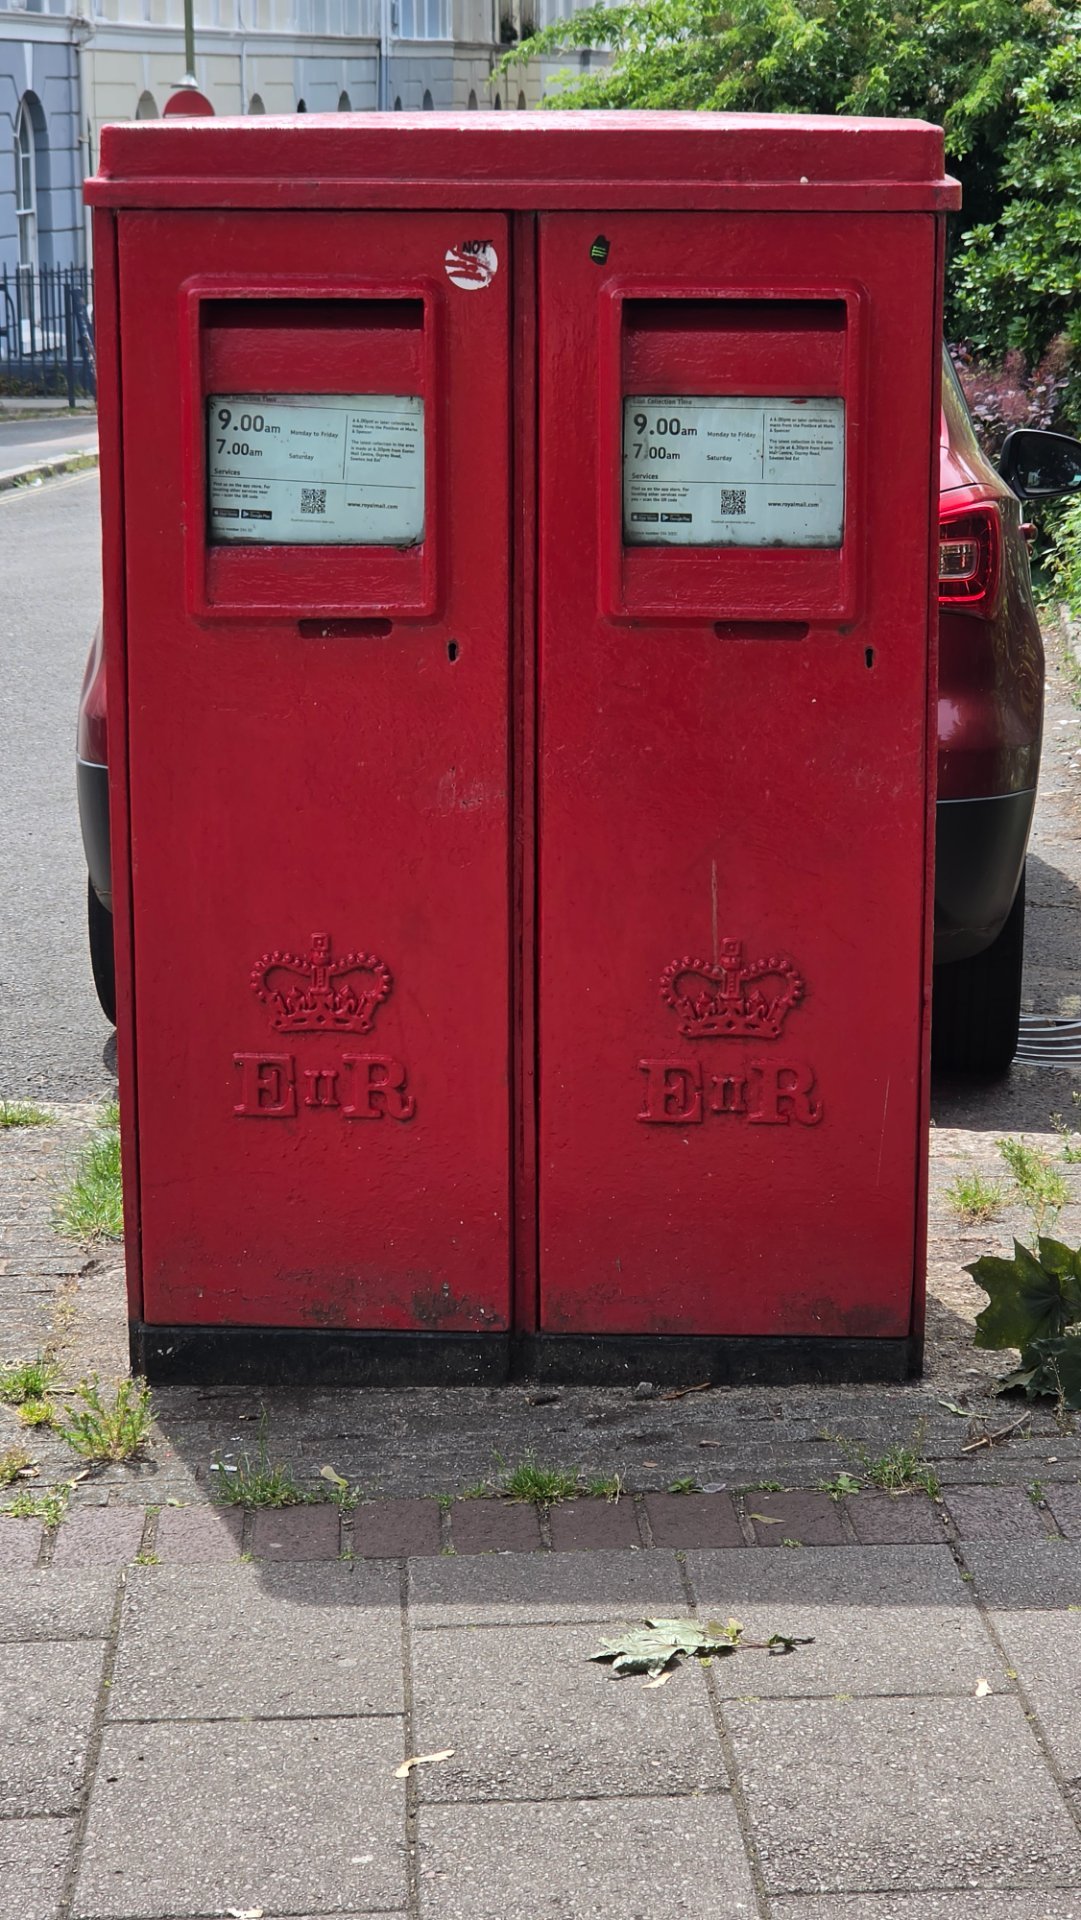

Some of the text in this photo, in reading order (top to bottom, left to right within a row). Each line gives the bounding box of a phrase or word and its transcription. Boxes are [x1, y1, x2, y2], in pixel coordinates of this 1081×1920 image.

[462, 240, 493, 254] NOT
[218, 409, 281, 433] 9.00am
[634, 413, 697, 436] 9.00am
[216, 439, 263, 456] 7.00am
[289, 453, 314, 461] Saturday
[706, 454, 732, 462] Saturday
[214, 468, 240, 476] Services
[347, 502, 398, 510] www.royalmail.com
